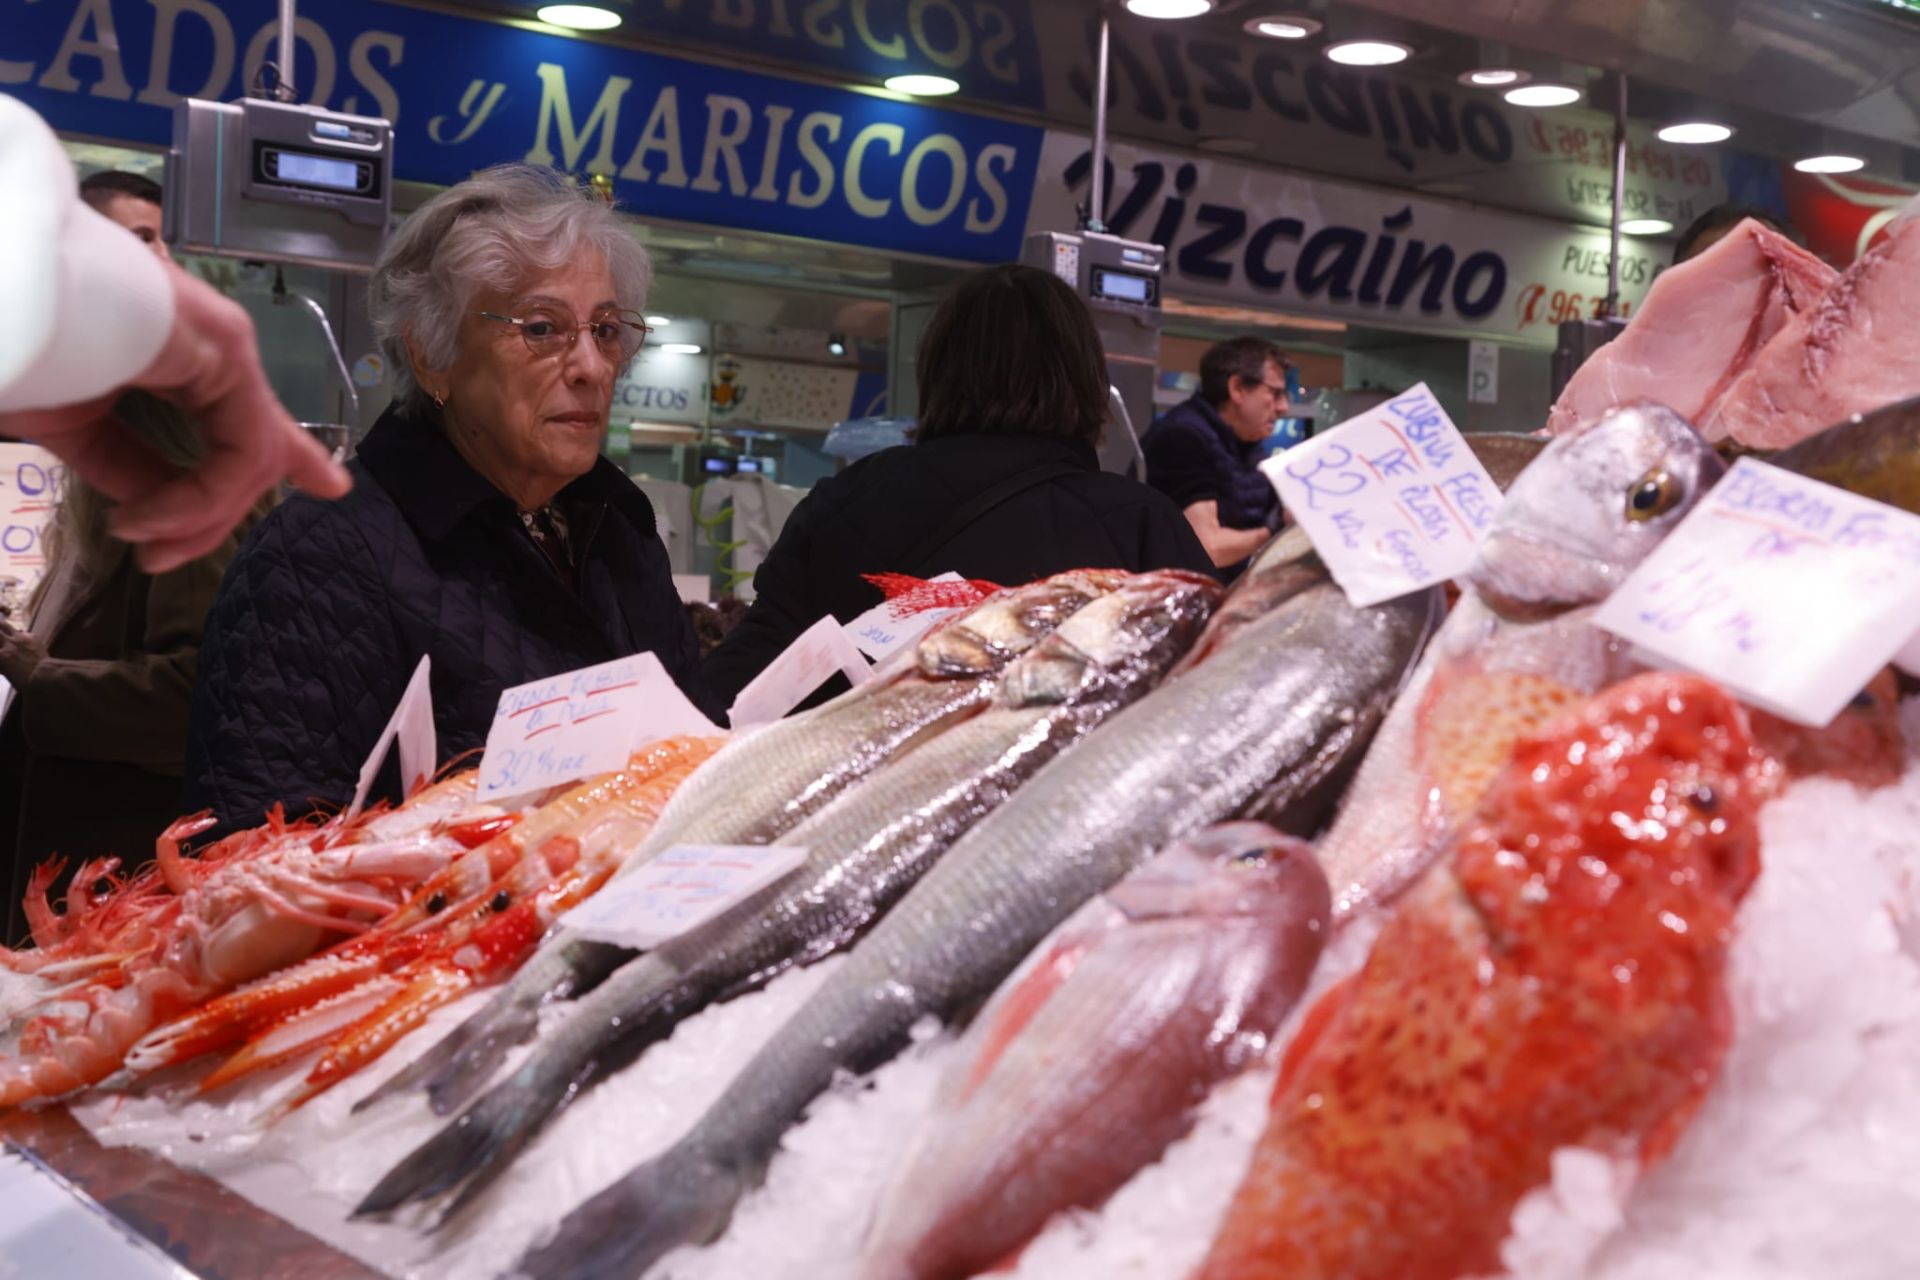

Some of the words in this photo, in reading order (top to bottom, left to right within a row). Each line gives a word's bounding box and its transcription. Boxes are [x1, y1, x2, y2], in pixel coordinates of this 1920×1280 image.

[427, 79, 506, 144] y
[529, 62, 1017, 235] MARISCOS
[1063, 149, 1508, 319] Vizcaíno
[1562, 244, 1649, 285] PUESOS
